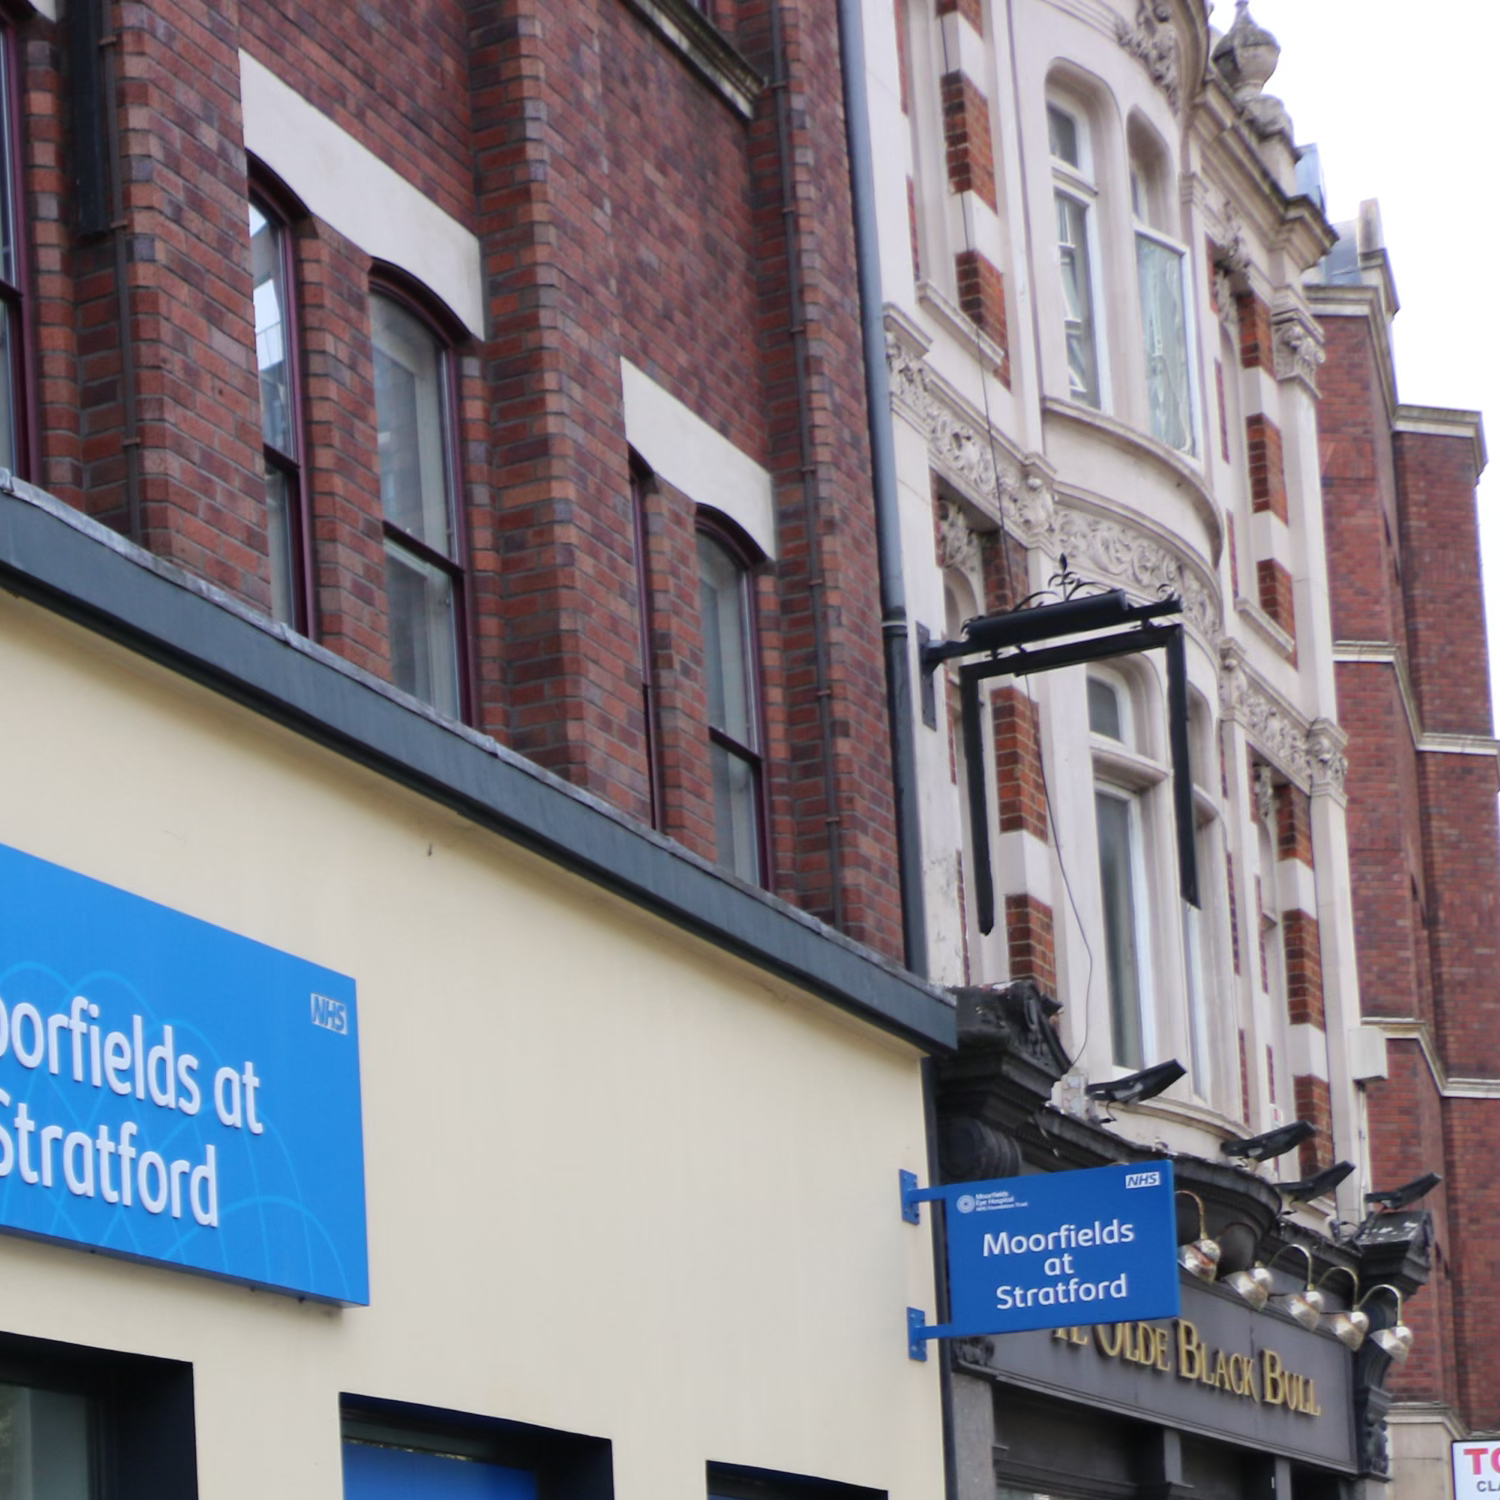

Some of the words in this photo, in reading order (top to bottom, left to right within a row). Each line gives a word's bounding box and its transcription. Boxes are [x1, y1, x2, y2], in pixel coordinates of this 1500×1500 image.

[311, 993, 347, 1034] NHS
[213, 1060, 264, 1135] at
[976, 1191, 1009, 1199] Moorfields
[1126, 1173, 1159, 1188] NHS
[983, 1218, 1135, 1257] Moorfields
[1043, 1252, 1074, 1276] at
[996, 1273, 1128, 1310] Stratford
[1264, 1349, 1321, 1417] BULL
